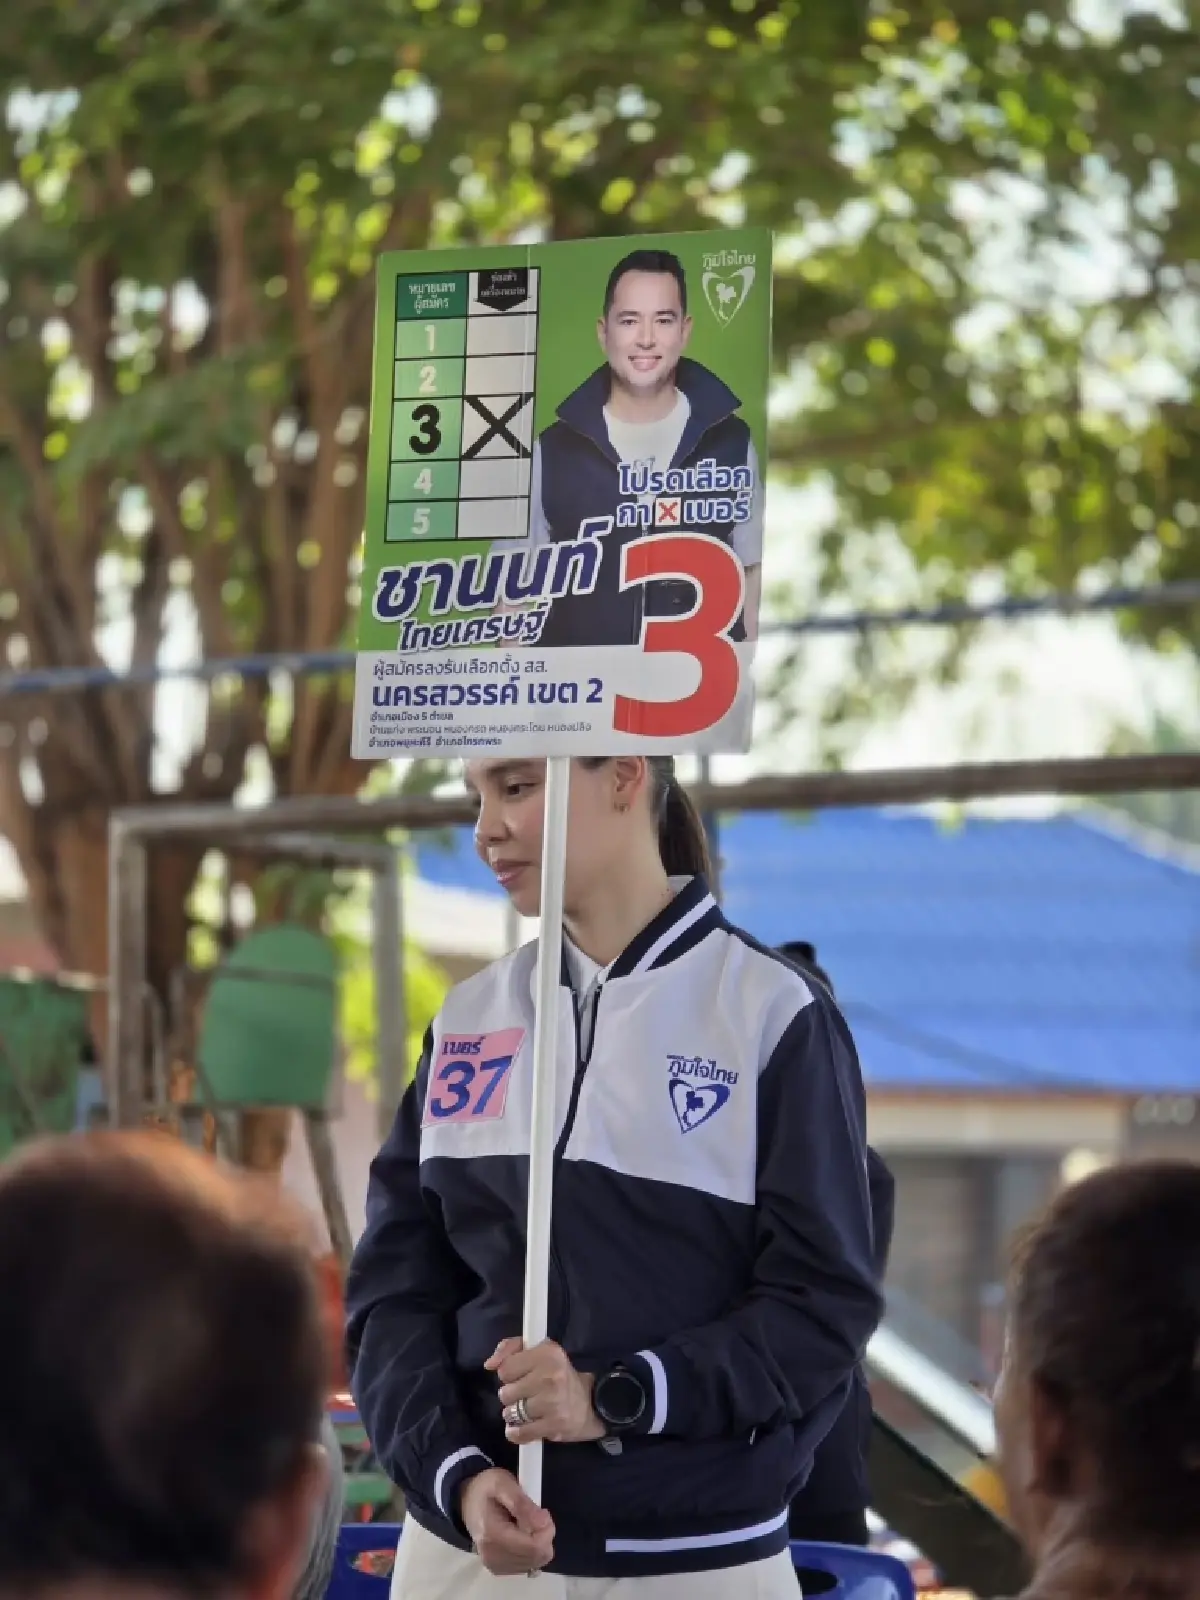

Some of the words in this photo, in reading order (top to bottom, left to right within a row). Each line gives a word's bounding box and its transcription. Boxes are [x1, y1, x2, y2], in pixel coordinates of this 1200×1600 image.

[408, 283, 456, 295] หมายเลข
[413, 295, 449, 315] ผู้สมัคร
[425, 324, 437, 352] 1
[419, 365, 437, 393] 2
[409, 403, 442, 455] 3
[413, 468, 433, 495] 4
[617, 459, 752, 494] โปรดเลือก
[411, 508, 431, 535] 5
[617, 503, 651, 527] กา
[684, 490, 752, 523] เบอร์
[373, 516, 613, 621] ชานนท์
[399, 599, 552, 652] ไทยเศรษฐ์
[612, 532, 745, 738] 3
[373, 653, 520, 680] ผู้สมัครลงรับเลือกตั้ง
[524, 660, 548, 674] สส.
[372, 675, 521, 707] นครสวรรค์
[527, 681, 579, 704] เขต
[585, 677, 604, 703] 2
[421, 711, 428, 721] 5
[441, 1035, 487, 1056] เบอร์
[668, 1056, 740, 1085] ภูมิใจไทย
[430, 1055, 513, 1118] 37
